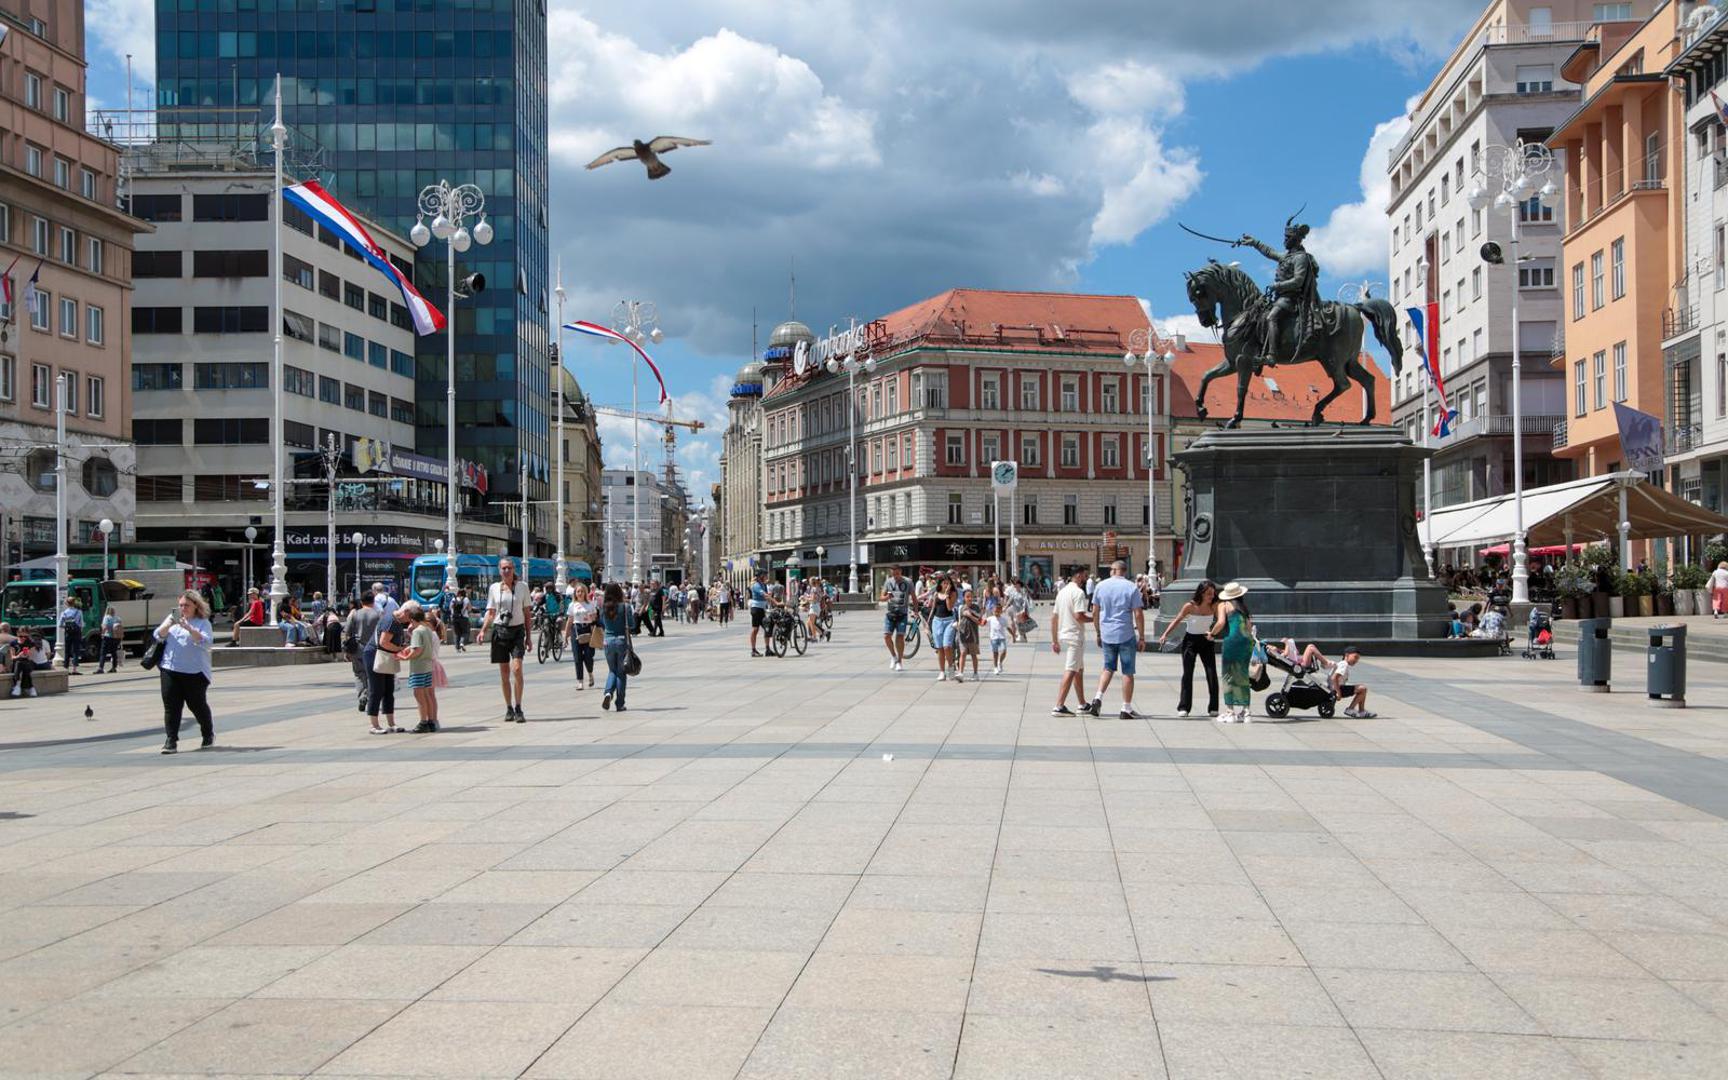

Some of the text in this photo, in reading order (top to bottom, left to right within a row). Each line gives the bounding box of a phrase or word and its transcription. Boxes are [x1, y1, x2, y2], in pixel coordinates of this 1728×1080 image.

[286, 533, 310, 545] Kad
[313, 533, 340, 545] znš
[343, 533, 378, 547] bje,
